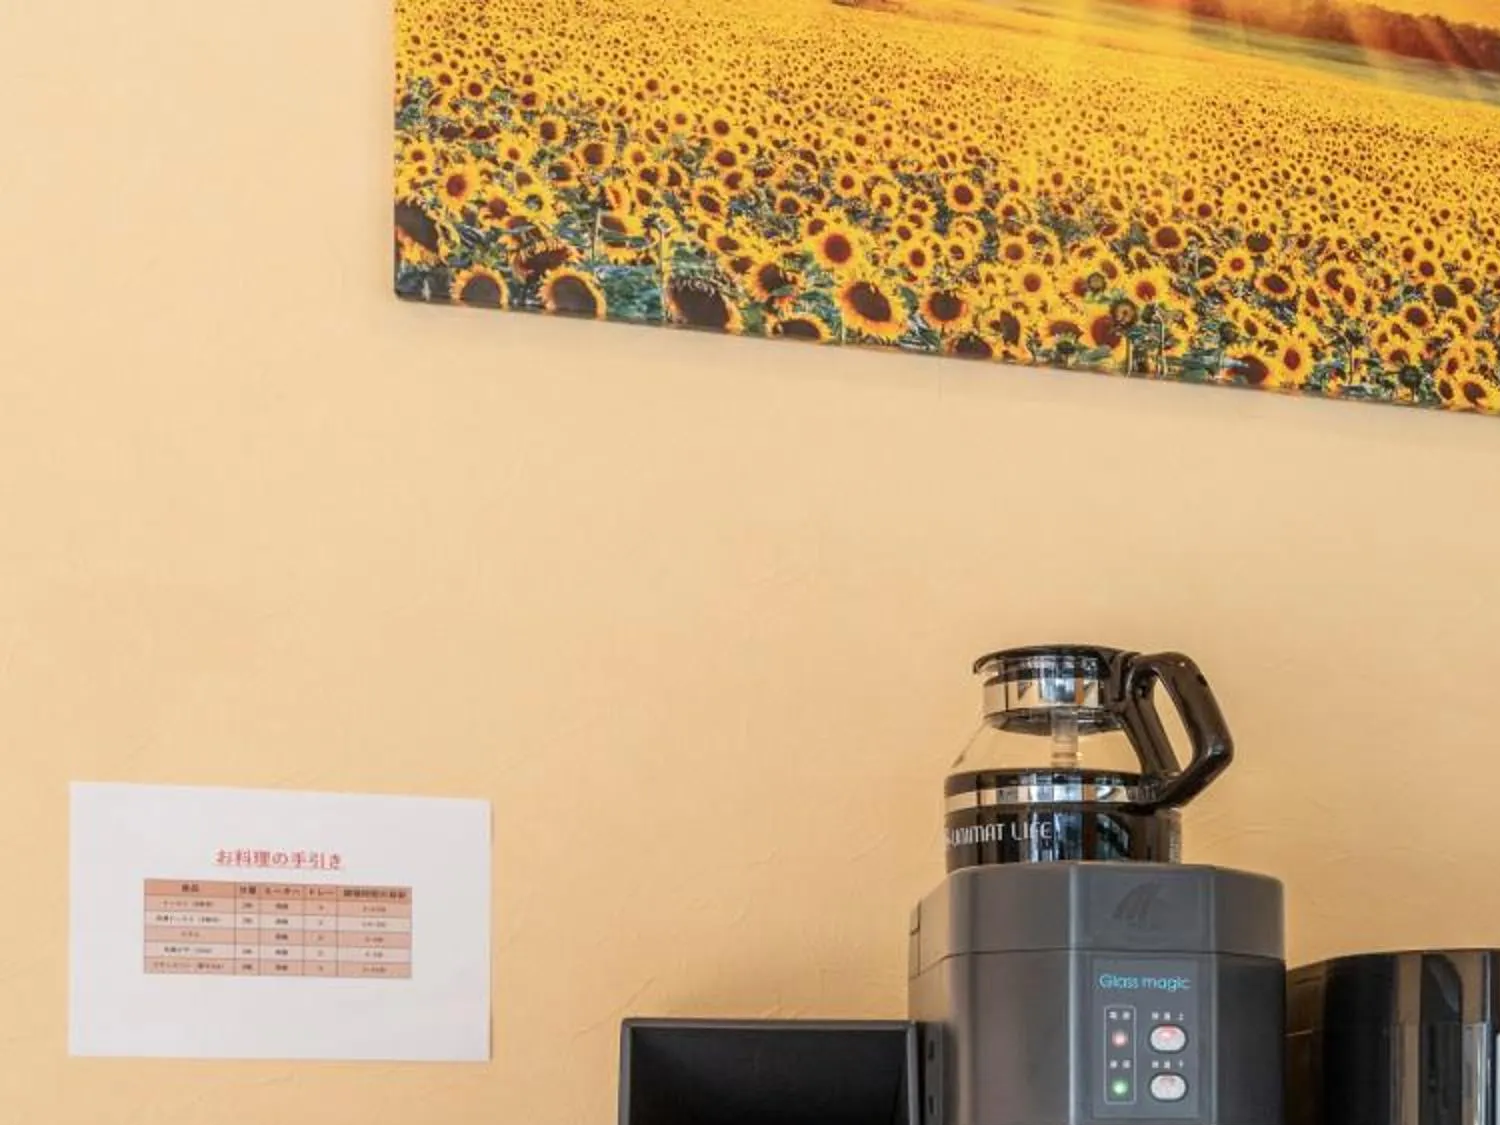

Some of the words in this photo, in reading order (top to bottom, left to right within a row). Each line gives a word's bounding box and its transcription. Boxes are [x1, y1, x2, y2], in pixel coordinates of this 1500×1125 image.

[1011, 821, 1052, 841] LIFE
[214, 848, 342, 871] お料理の手引き
[1099, 973, 1138, 989] Glass
[1141, 974, 1191, 992] magic
